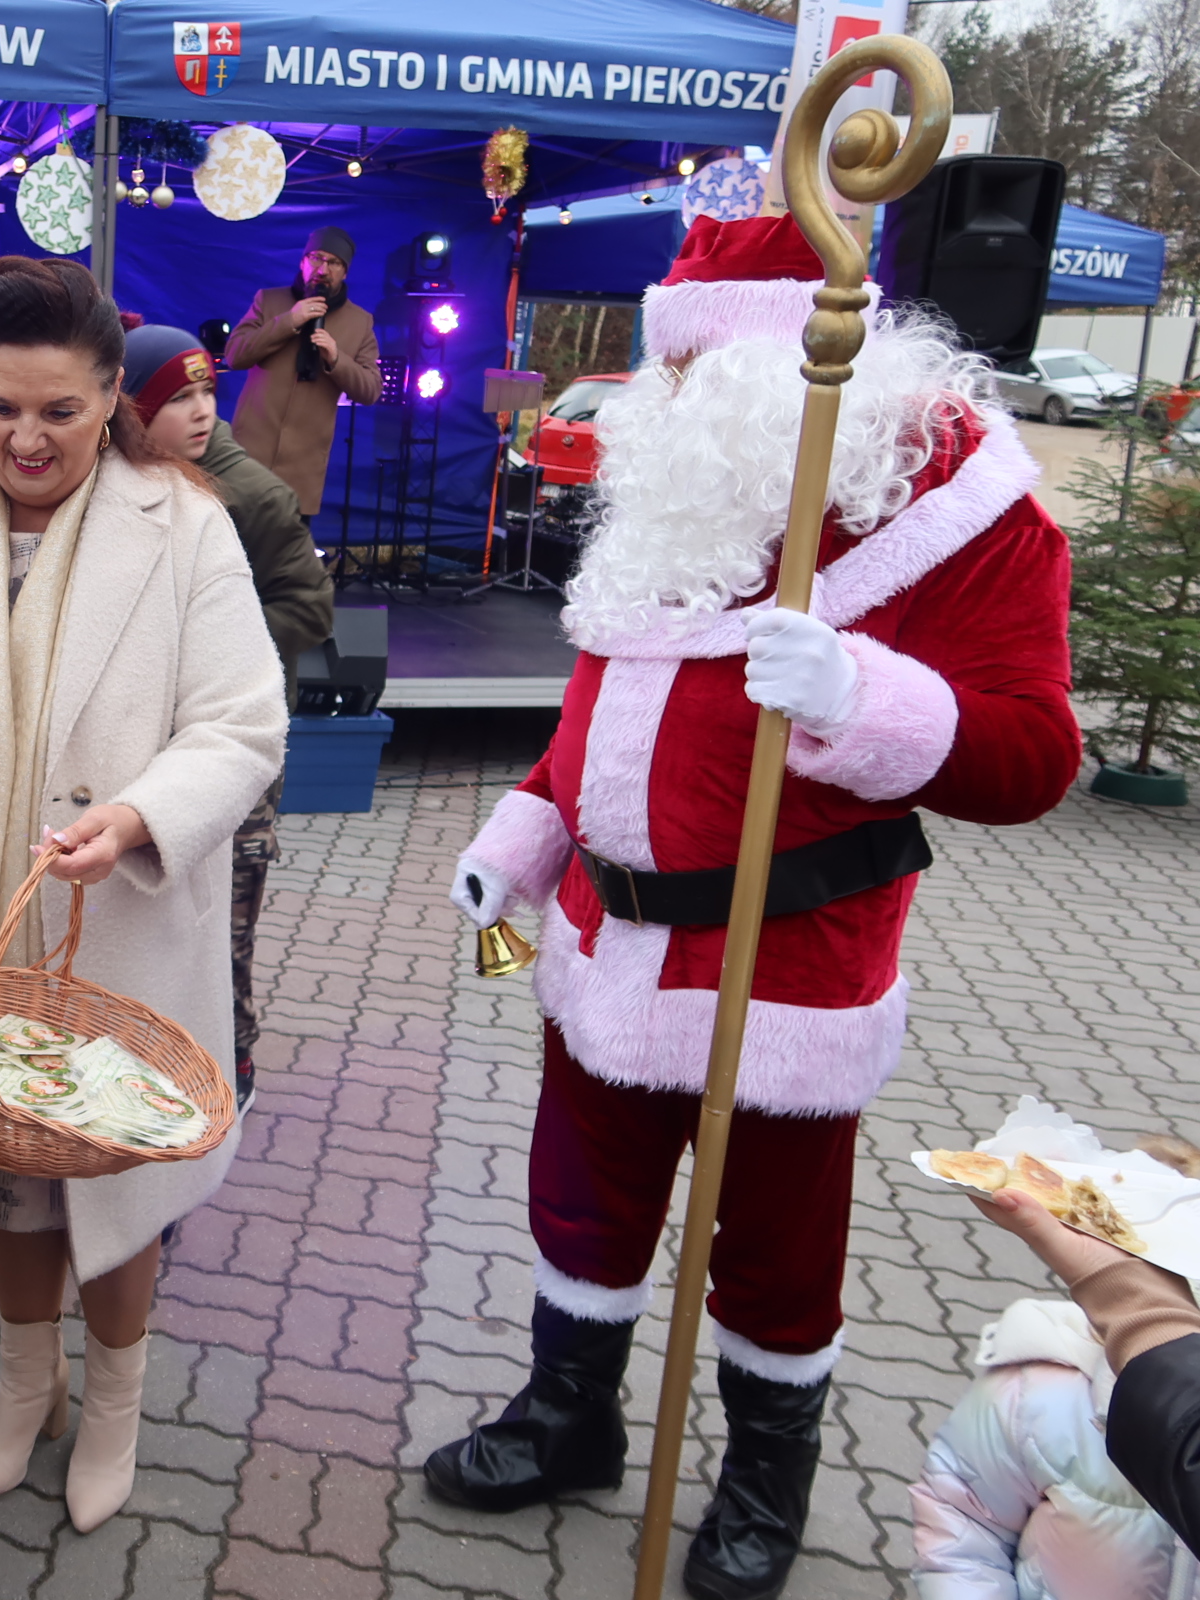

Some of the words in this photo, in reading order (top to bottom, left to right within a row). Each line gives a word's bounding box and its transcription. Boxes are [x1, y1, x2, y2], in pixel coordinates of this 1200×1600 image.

[264, 45, 425, 90] MIASTO
[436, 54, 447, 91] I
[460, 56, 594, 99] GMINA
